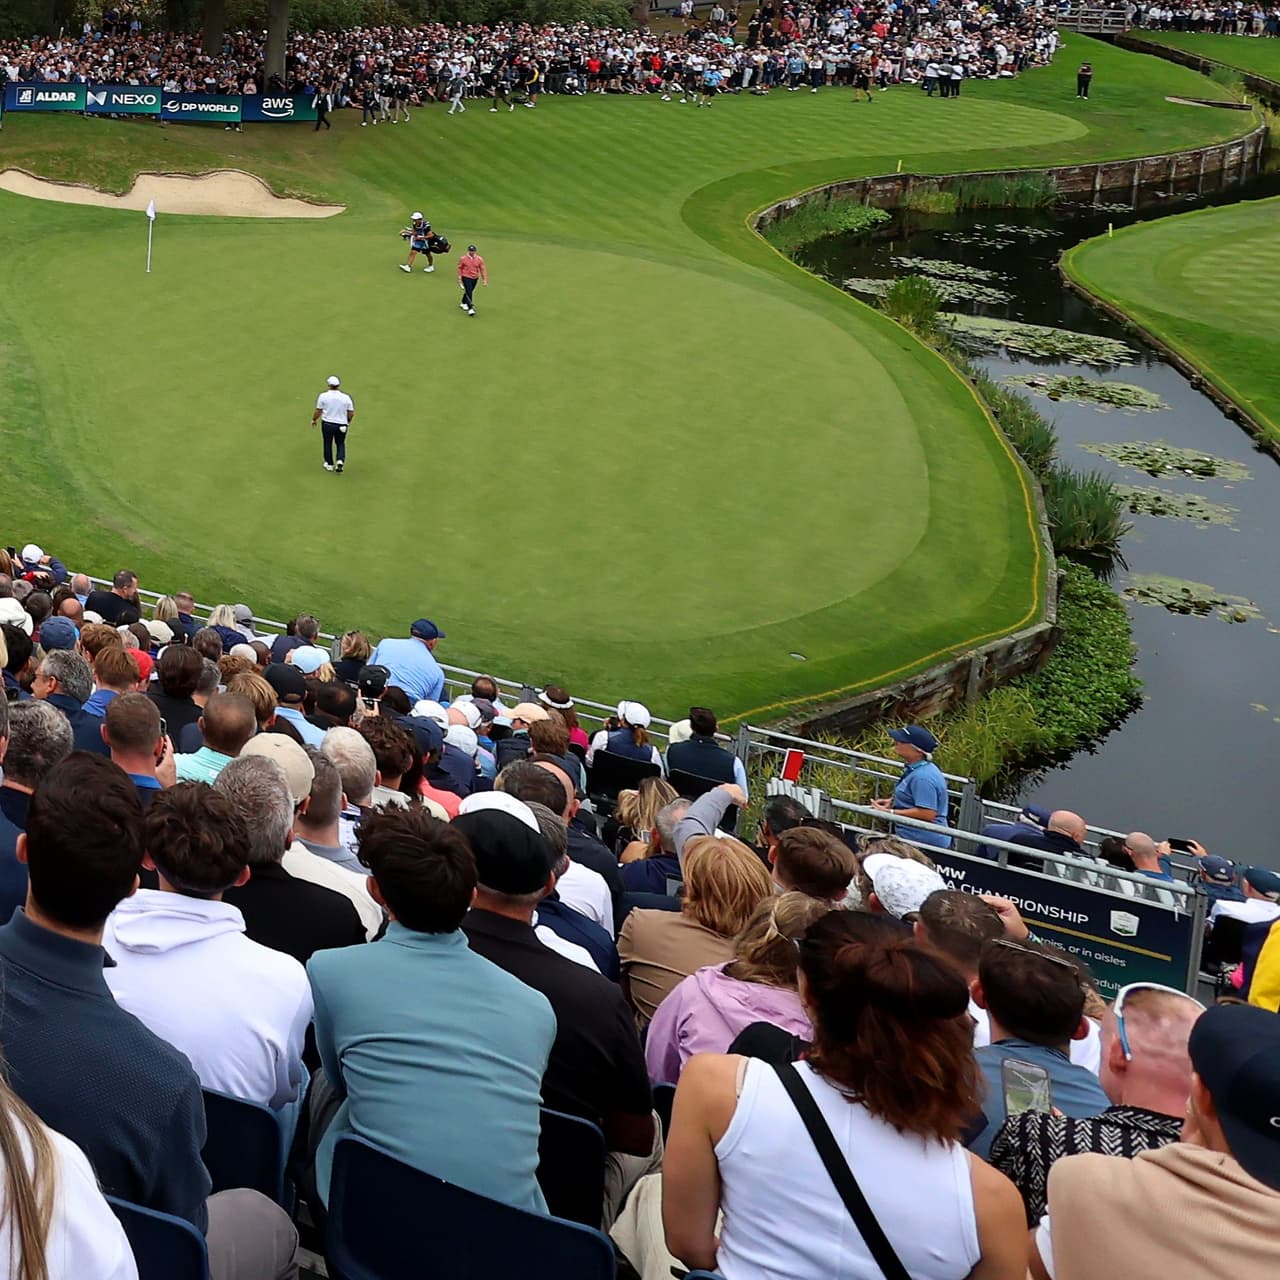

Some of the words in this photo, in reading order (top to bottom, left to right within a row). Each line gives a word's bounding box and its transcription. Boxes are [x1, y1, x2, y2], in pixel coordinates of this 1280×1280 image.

[36, 92, 76, 101] ALDAR
[112, 94, 156, 105] NEXO
[181, 103, 197, 111] DP
[197, 103, 239, 113] WORLD
[262, 97, 294, 109] aws
[933, 864, 966, 880] MW
[1068, 945, 1080, 953] or
[1082, 947, 1092, 957] in
[1094, 952, 1127, 967] aisles
